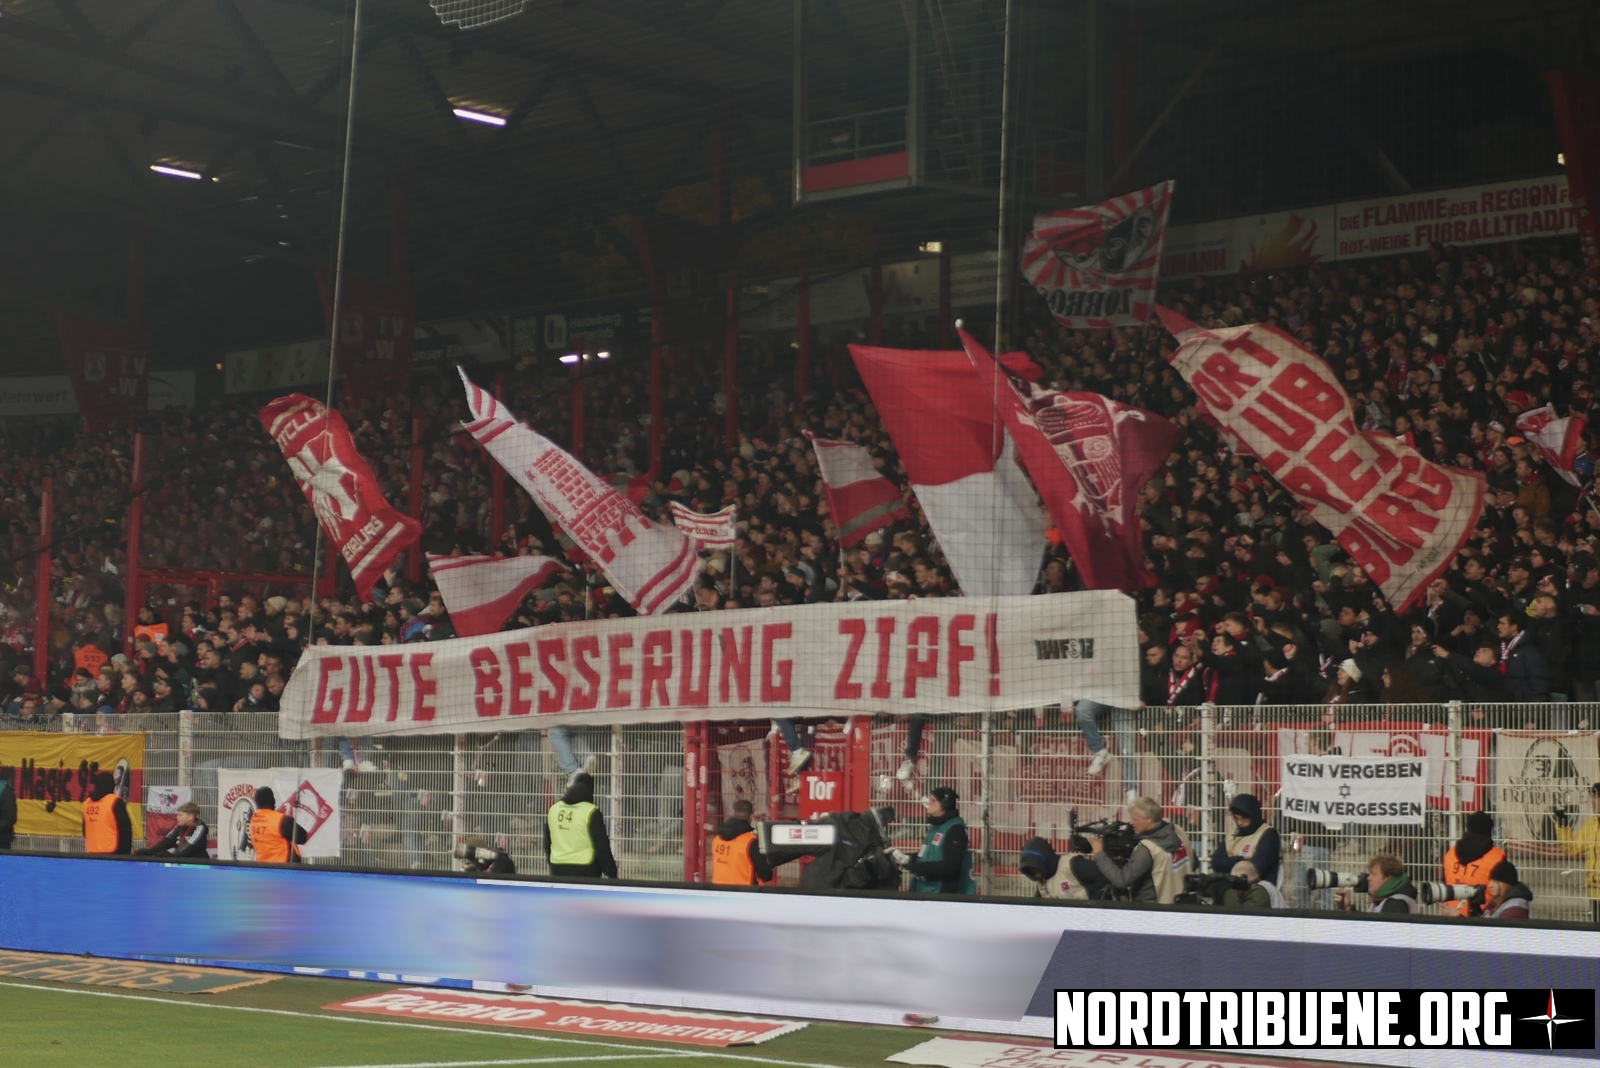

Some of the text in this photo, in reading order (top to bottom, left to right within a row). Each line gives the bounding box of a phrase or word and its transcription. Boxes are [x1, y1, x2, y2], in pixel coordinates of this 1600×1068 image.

[1340, 215, 1360, 230] DIE
[1450, 200, 1478, 217] DER
[1481, 183, 1557, 213] REGION
[1191, 330, 1279, 411] ORT
[311, 612, 1001, 724] GUTE BESSERUNG ZIPF!
[1286, 761, 1422, 779] KEIN VERGEBEN
[19, 757, 72, 813] Magic
[806, 775, 837, 800] Tor
[86, 805, 100, 815] 492
[557, 810, 573, 823] 64
[1285, 797, 1422, 816] KEIN VERGESSEN
[714, 845, 730, 856] 491
[341, 993, 760, 1043] Betano SPORTWETTEN
